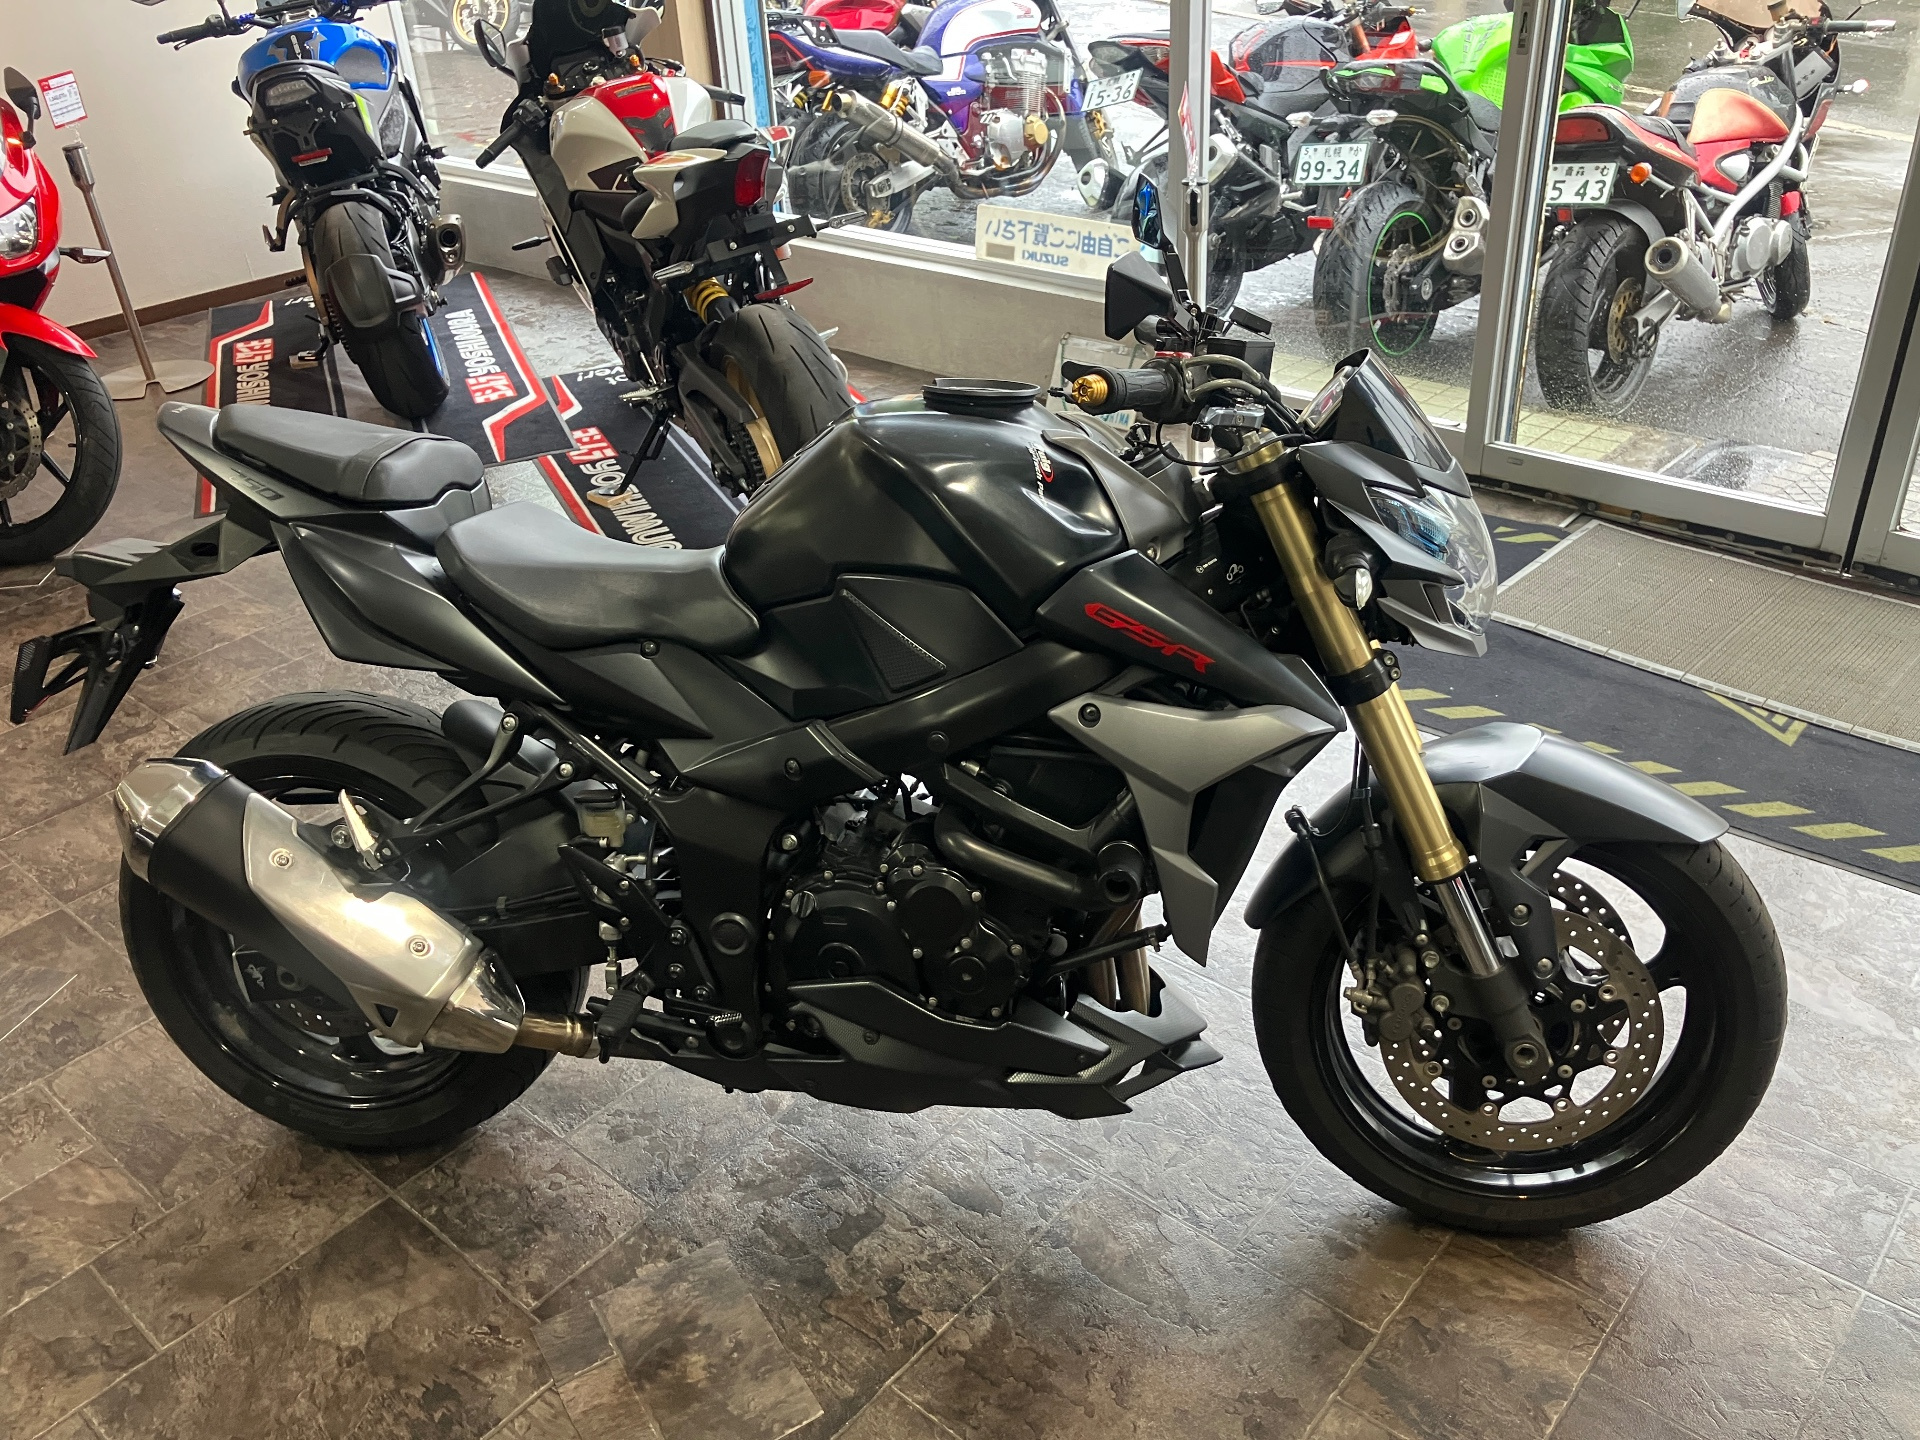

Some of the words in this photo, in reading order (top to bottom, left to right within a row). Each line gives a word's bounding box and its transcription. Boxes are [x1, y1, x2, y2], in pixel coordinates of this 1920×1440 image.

[1086, 82, 1134, 108] 15-36
[1299, 160, 1360, 181] 99-34
[445, 308, 502, 378] YOSHIMURA
[1084, 602, 1217, 674] GSR
